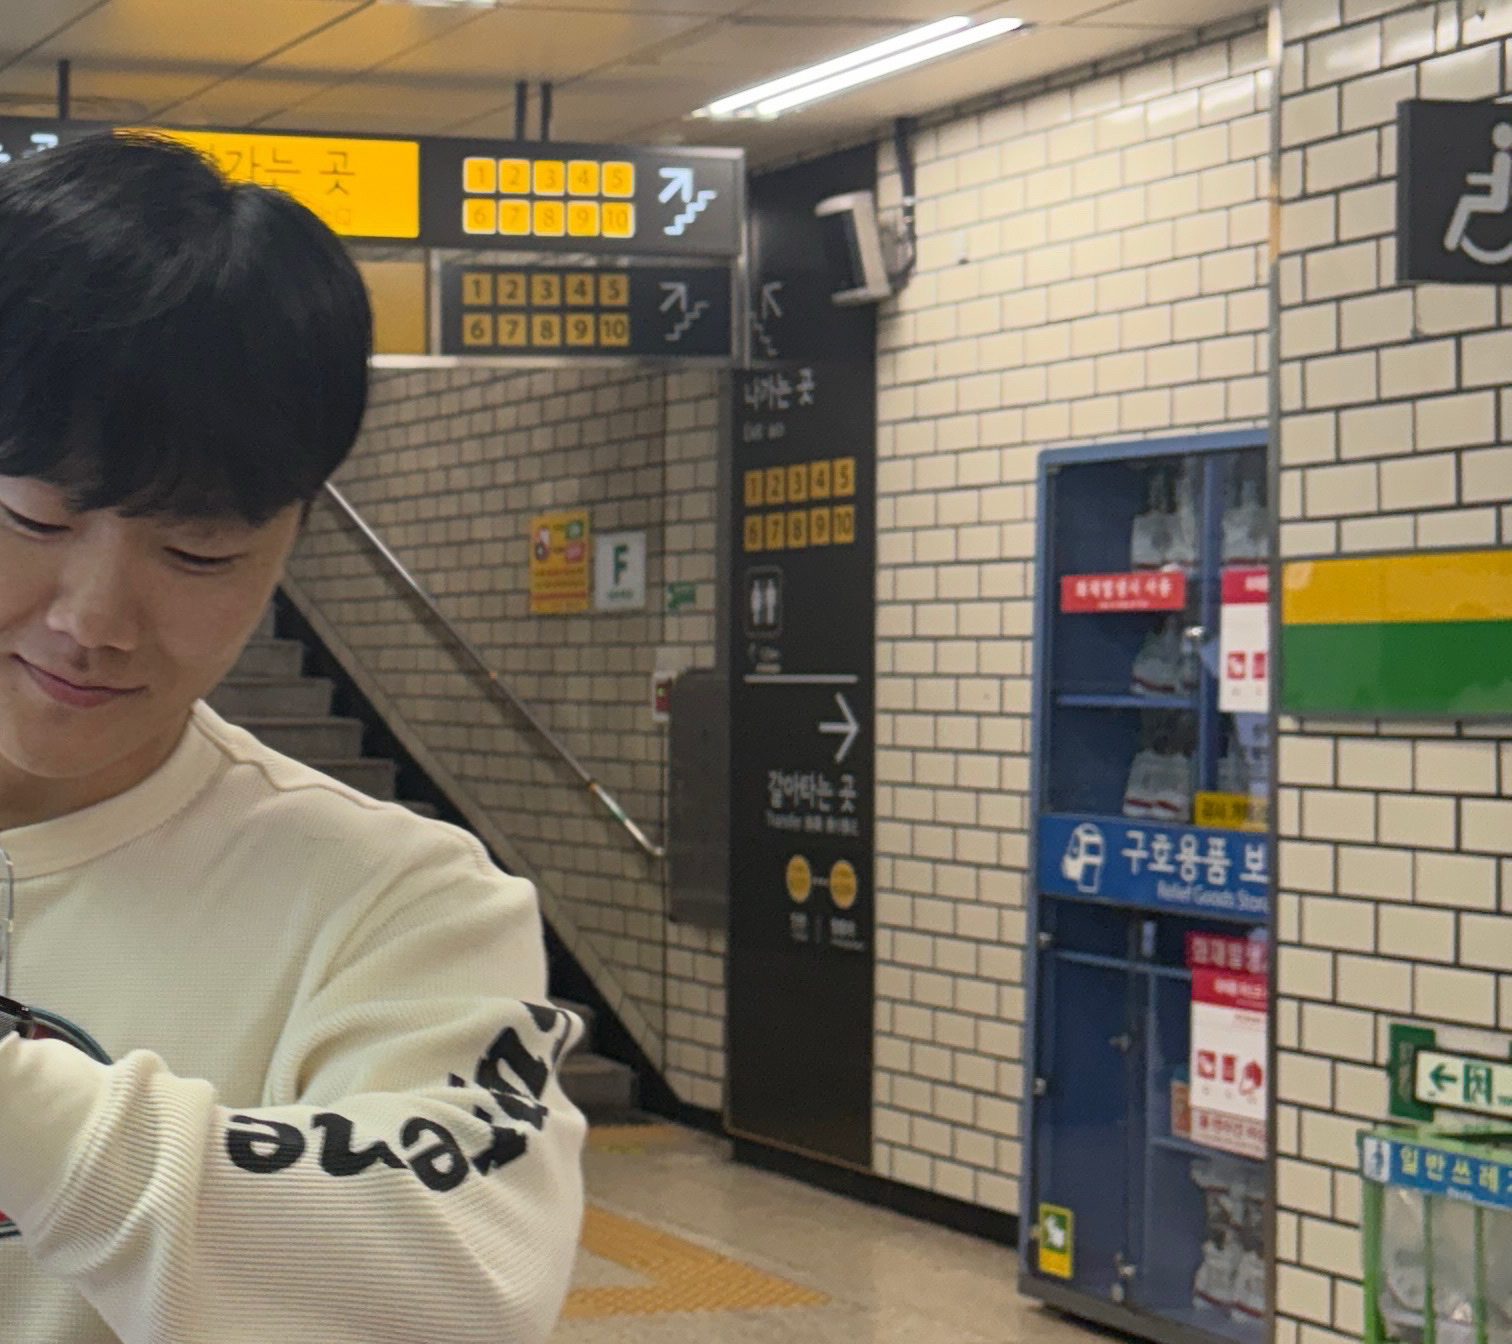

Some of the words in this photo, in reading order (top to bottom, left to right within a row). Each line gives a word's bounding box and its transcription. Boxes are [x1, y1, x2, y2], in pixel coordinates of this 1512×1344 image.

[319, 150, 356, 196] 곳
[470, 320, 485, 340] 6
[505, 320, 518, 339] 7
[540, 320, 554, 340] 8
[574, 320, 587, 340] 9
[604, 319, 626, 340] 10
[797, 367, 816, 406] 곳
[767, 769, 835, 813] 갈아타는
[839, 773, 857, 813] 곳
[1121, 829, 1232, 886] 구호용품
